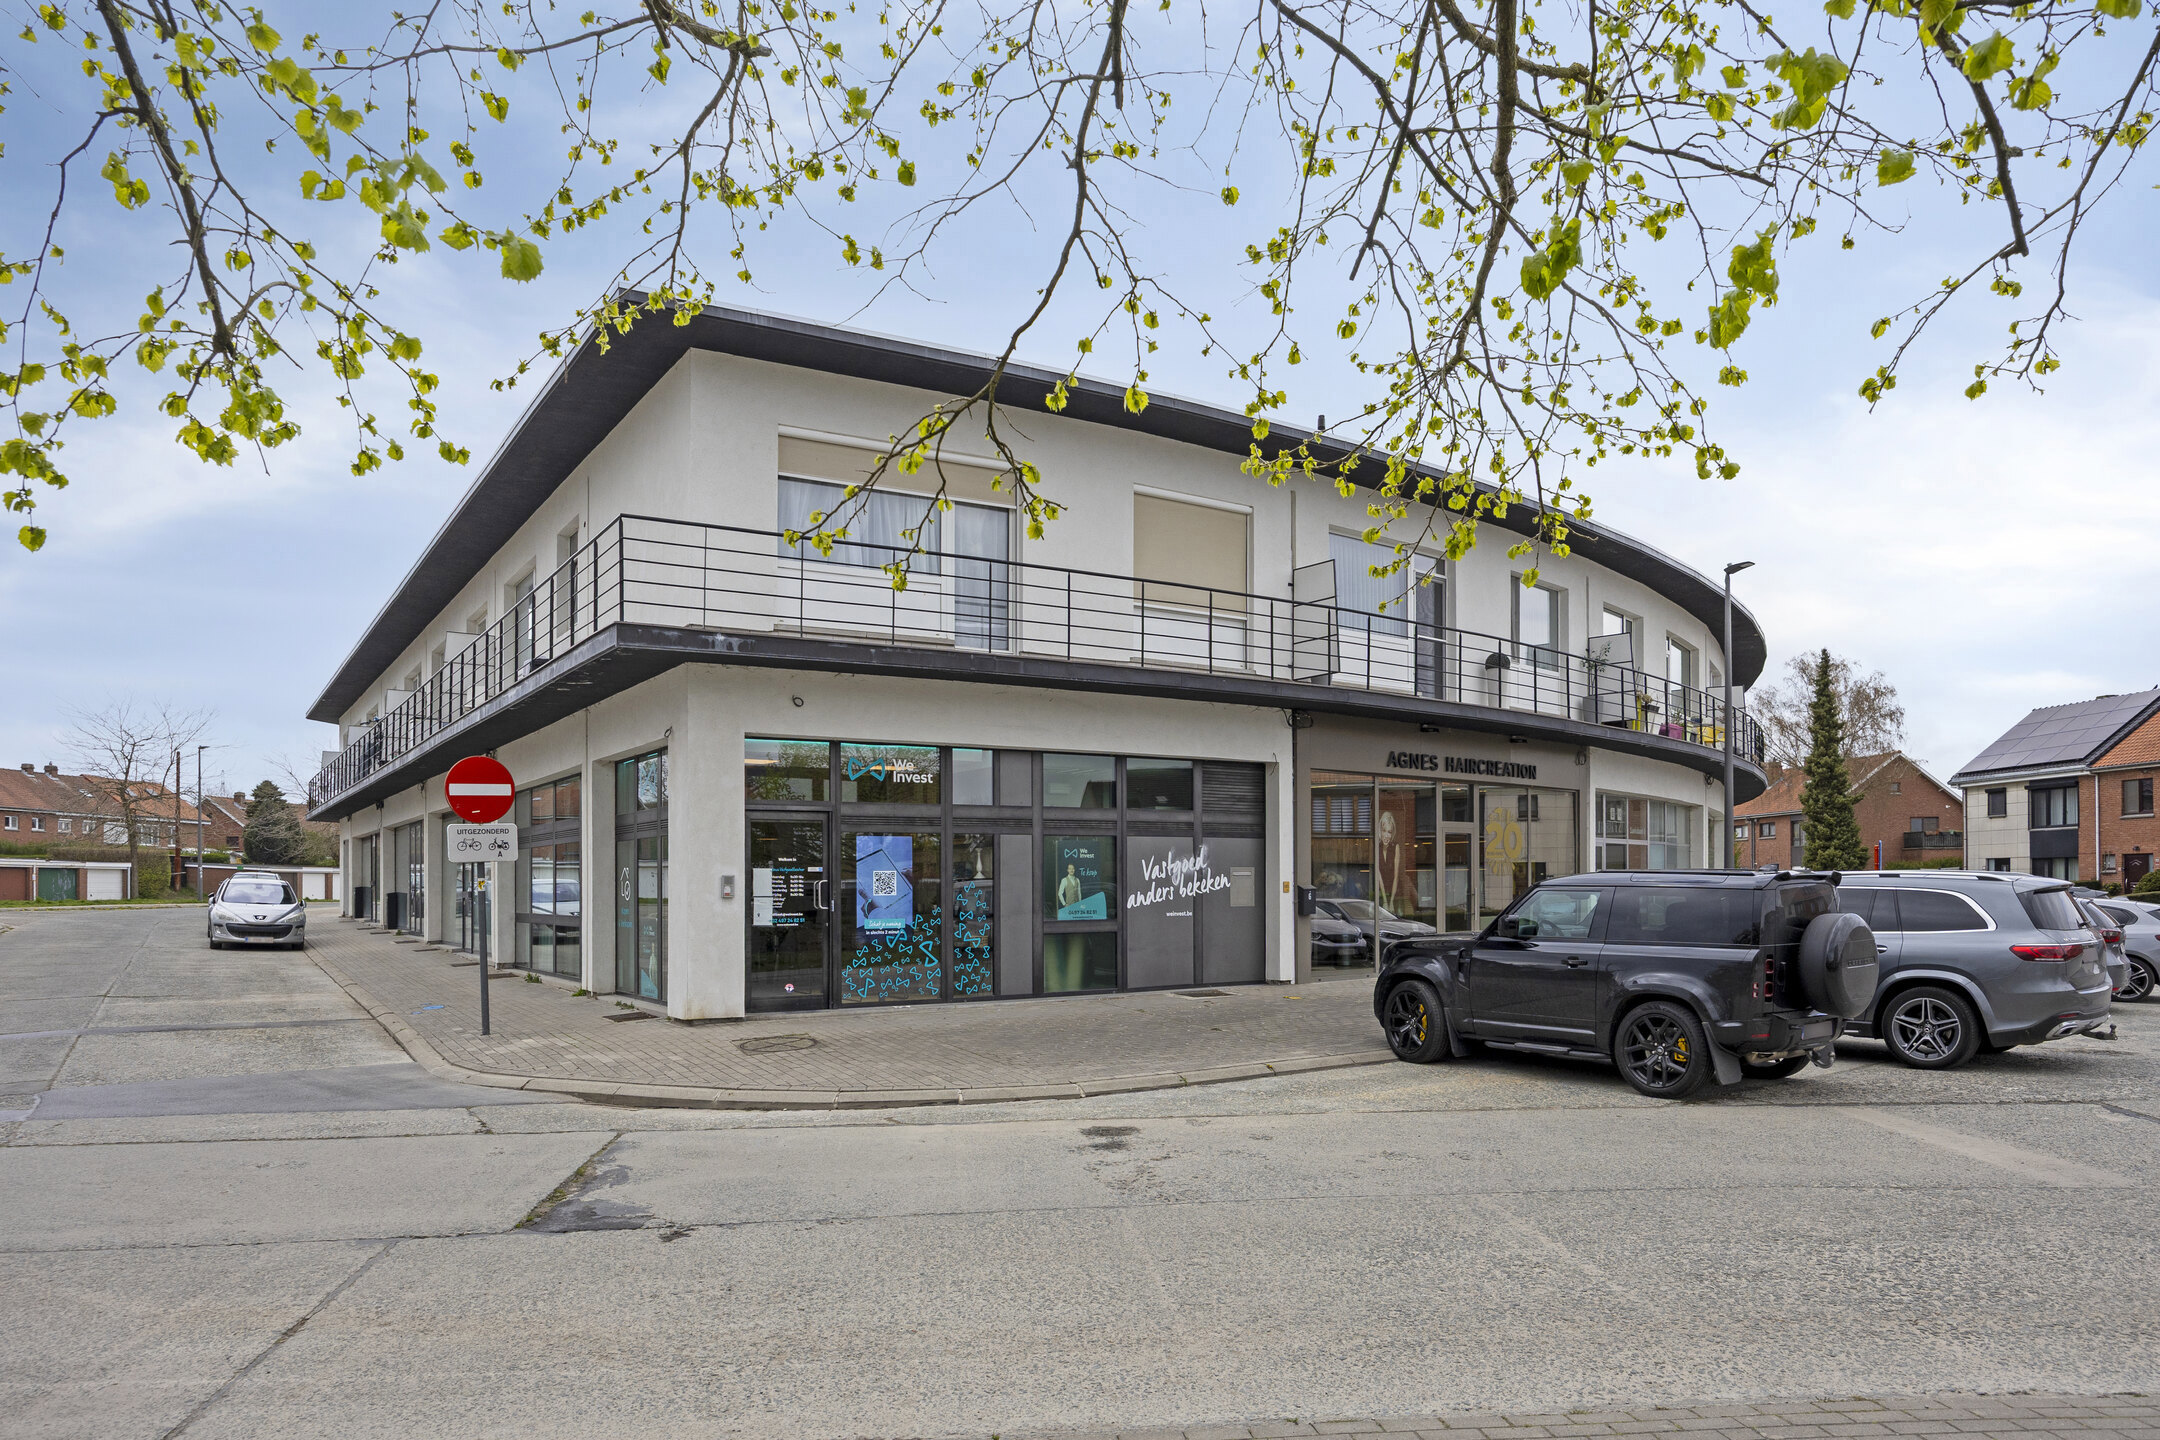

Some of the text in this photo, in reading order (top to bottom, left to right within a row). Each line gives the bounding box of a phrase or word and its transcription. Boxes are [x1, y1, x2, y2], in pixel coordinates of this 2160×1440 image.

[893, 758, 914, 771] We
[893, 771, 934, 784] Invest
[1386, 750, 1537, 780] AGNES HAIRCREATION
[1486, 821, 1523, 859] 20
[1141, 845, 1207, 886] Vastgoed
[1127, 867, 1231, 909] anders bekeken
